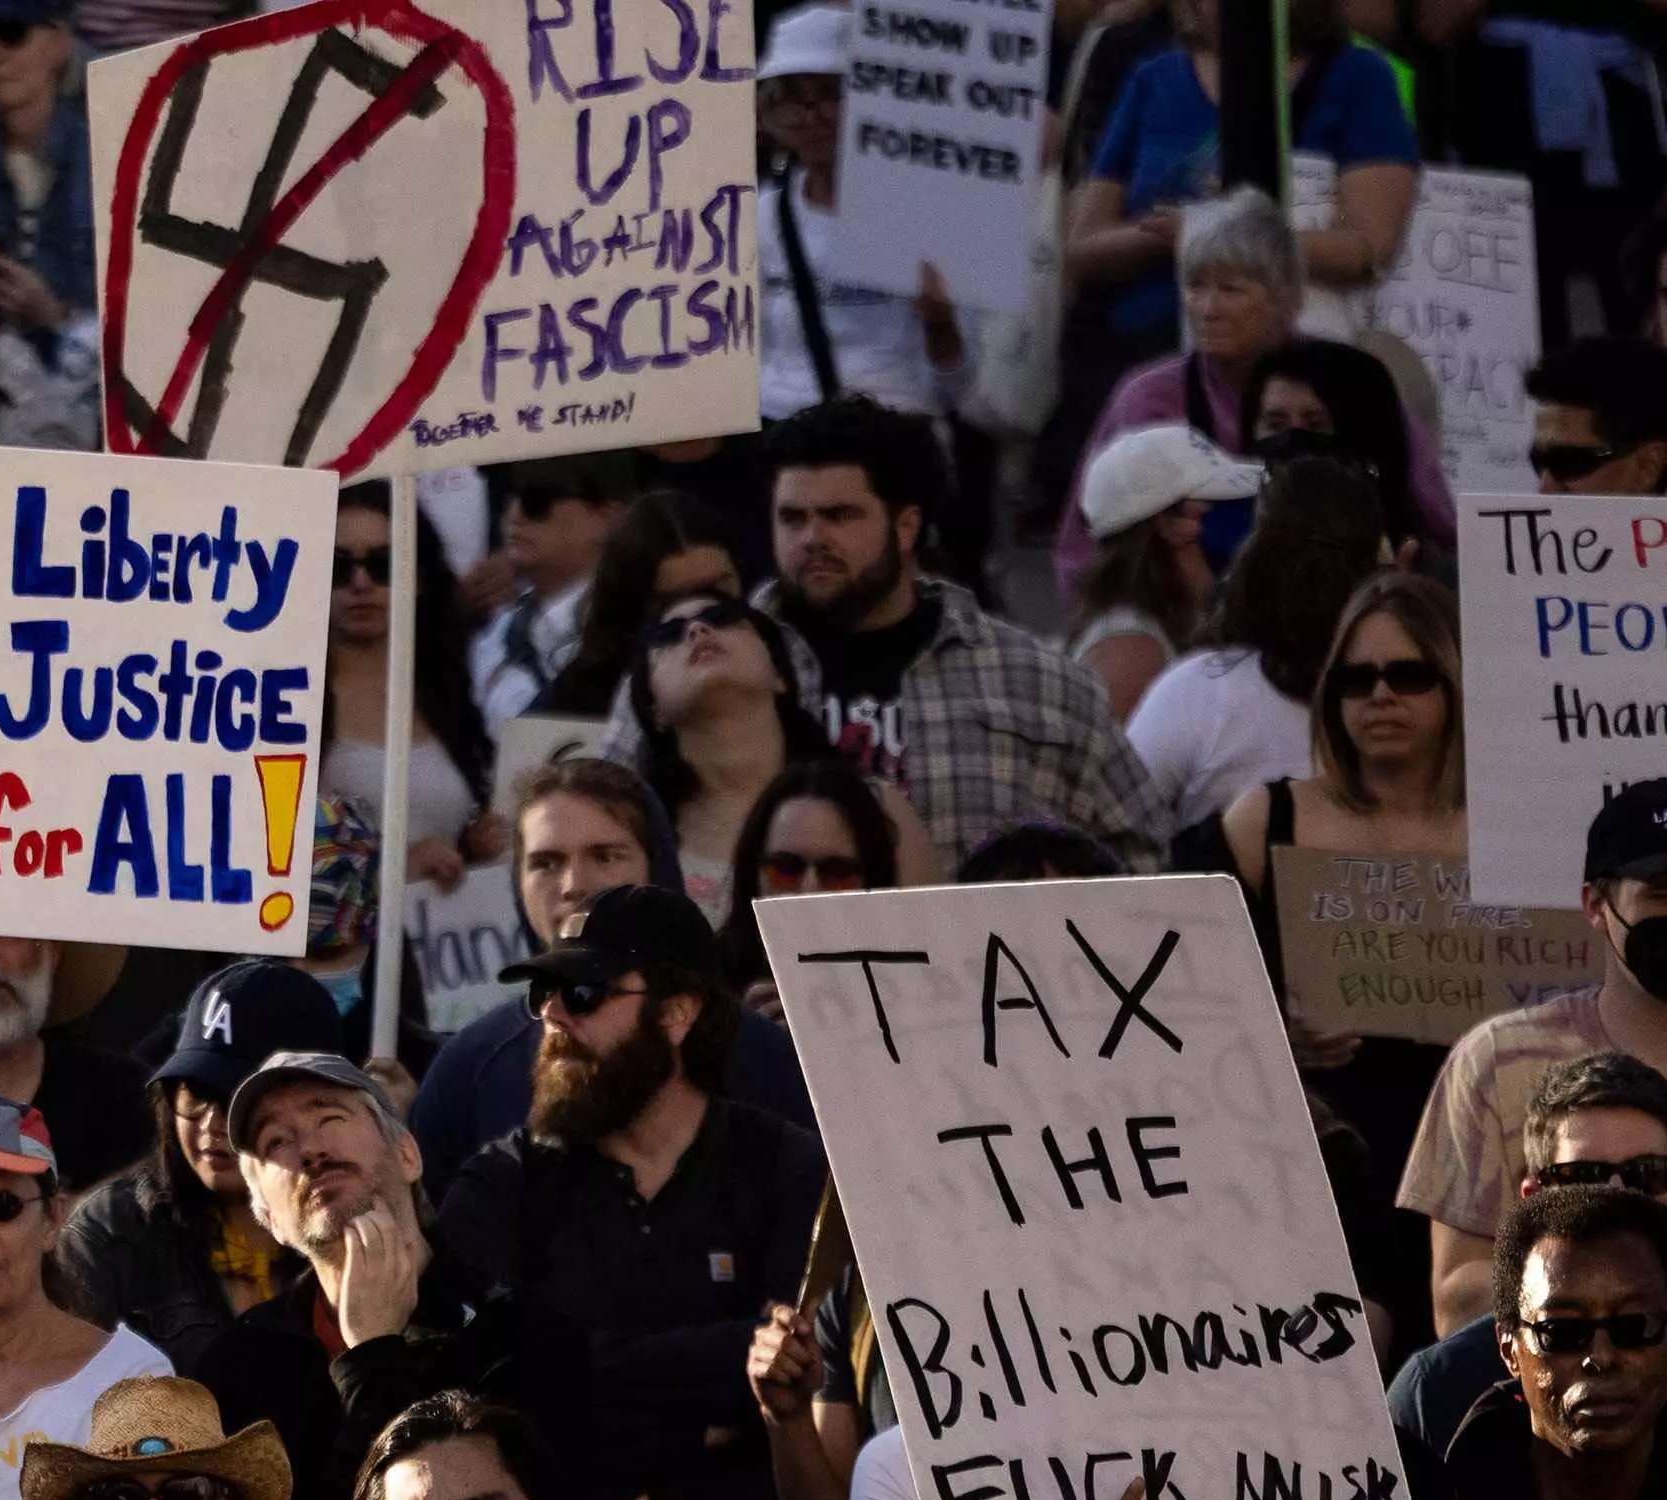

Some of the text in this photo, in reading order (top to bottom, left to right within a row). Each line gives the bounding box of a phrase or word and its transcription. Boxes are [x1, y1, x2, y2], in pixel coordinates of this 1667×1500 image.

[528, 0, 756, 101] RISE
[863, 6, 1039, 67] SHOW UP
[851, 61, 1035, 122] SPEAK OUT
[576, 99, 692, 213] UP
[859, 122, 1023, 185] FOREVER
[508, 185, 756, 278] AGAINST
[482, 280, 756, 402] FASCISM
[1477, 508, 1667, 576] The P
[1535, 596, 1667, 659] PEO
[86, 754, 308, 934] ALL!
[1333, 856, 1418, 894] THE
[1311, 893, 1355, 923] IS
[1370, 898, 1427, 925] ON
[1332, 929, 1590, 970] ARE YOU RICH
[797, 918, 1184, 1068] TAX
[1337, 972, 1486, 1012] ENOUGH
[937, 1116, 1190, 1228] THE
[886, 1287, 1364, 1440] Billionaires
